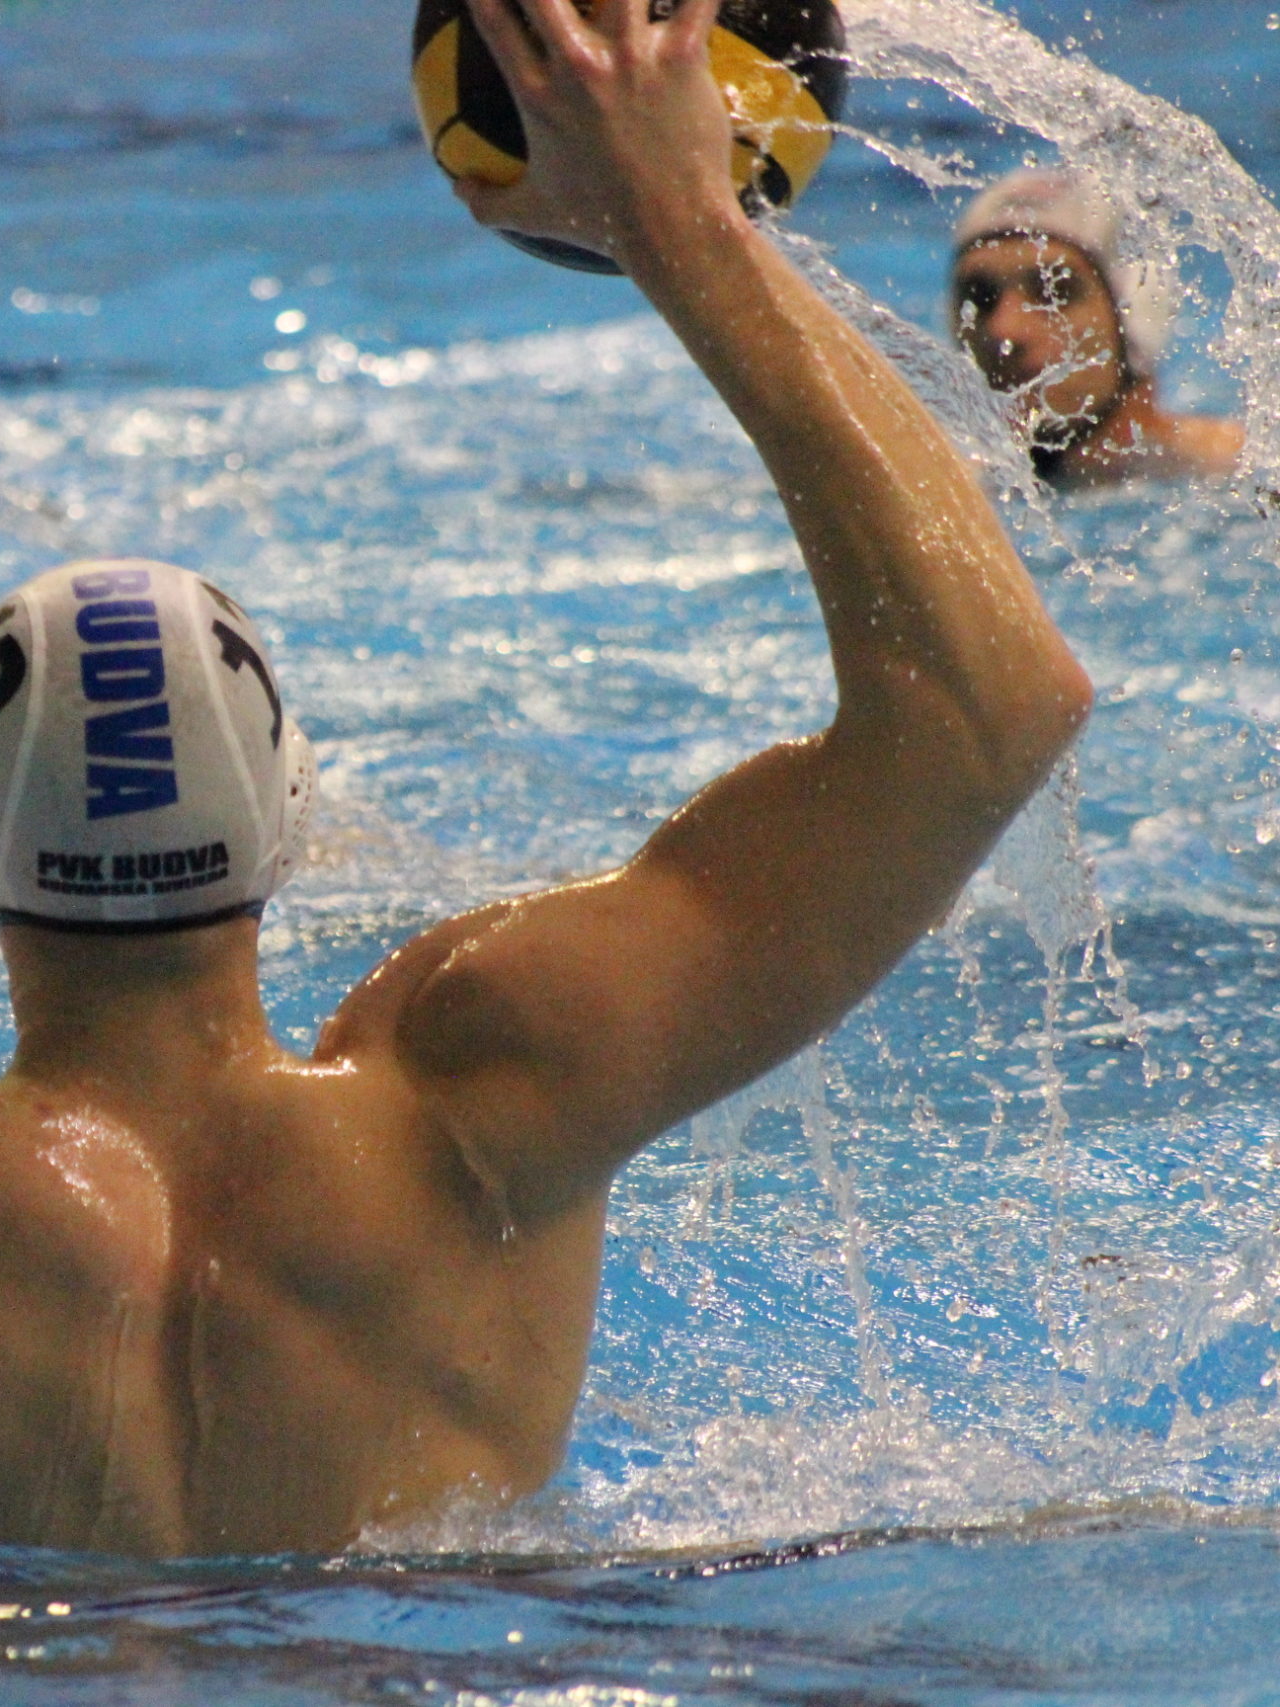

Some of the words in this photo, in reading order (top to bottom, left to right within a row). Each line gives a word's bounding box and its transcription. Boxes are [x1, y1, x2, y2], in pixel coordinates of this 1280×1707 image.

[71, 569, 179, 821] BUDVA
[37, 851, 104, 881] PVK
[112, 841, 230, 881] BUDVA
